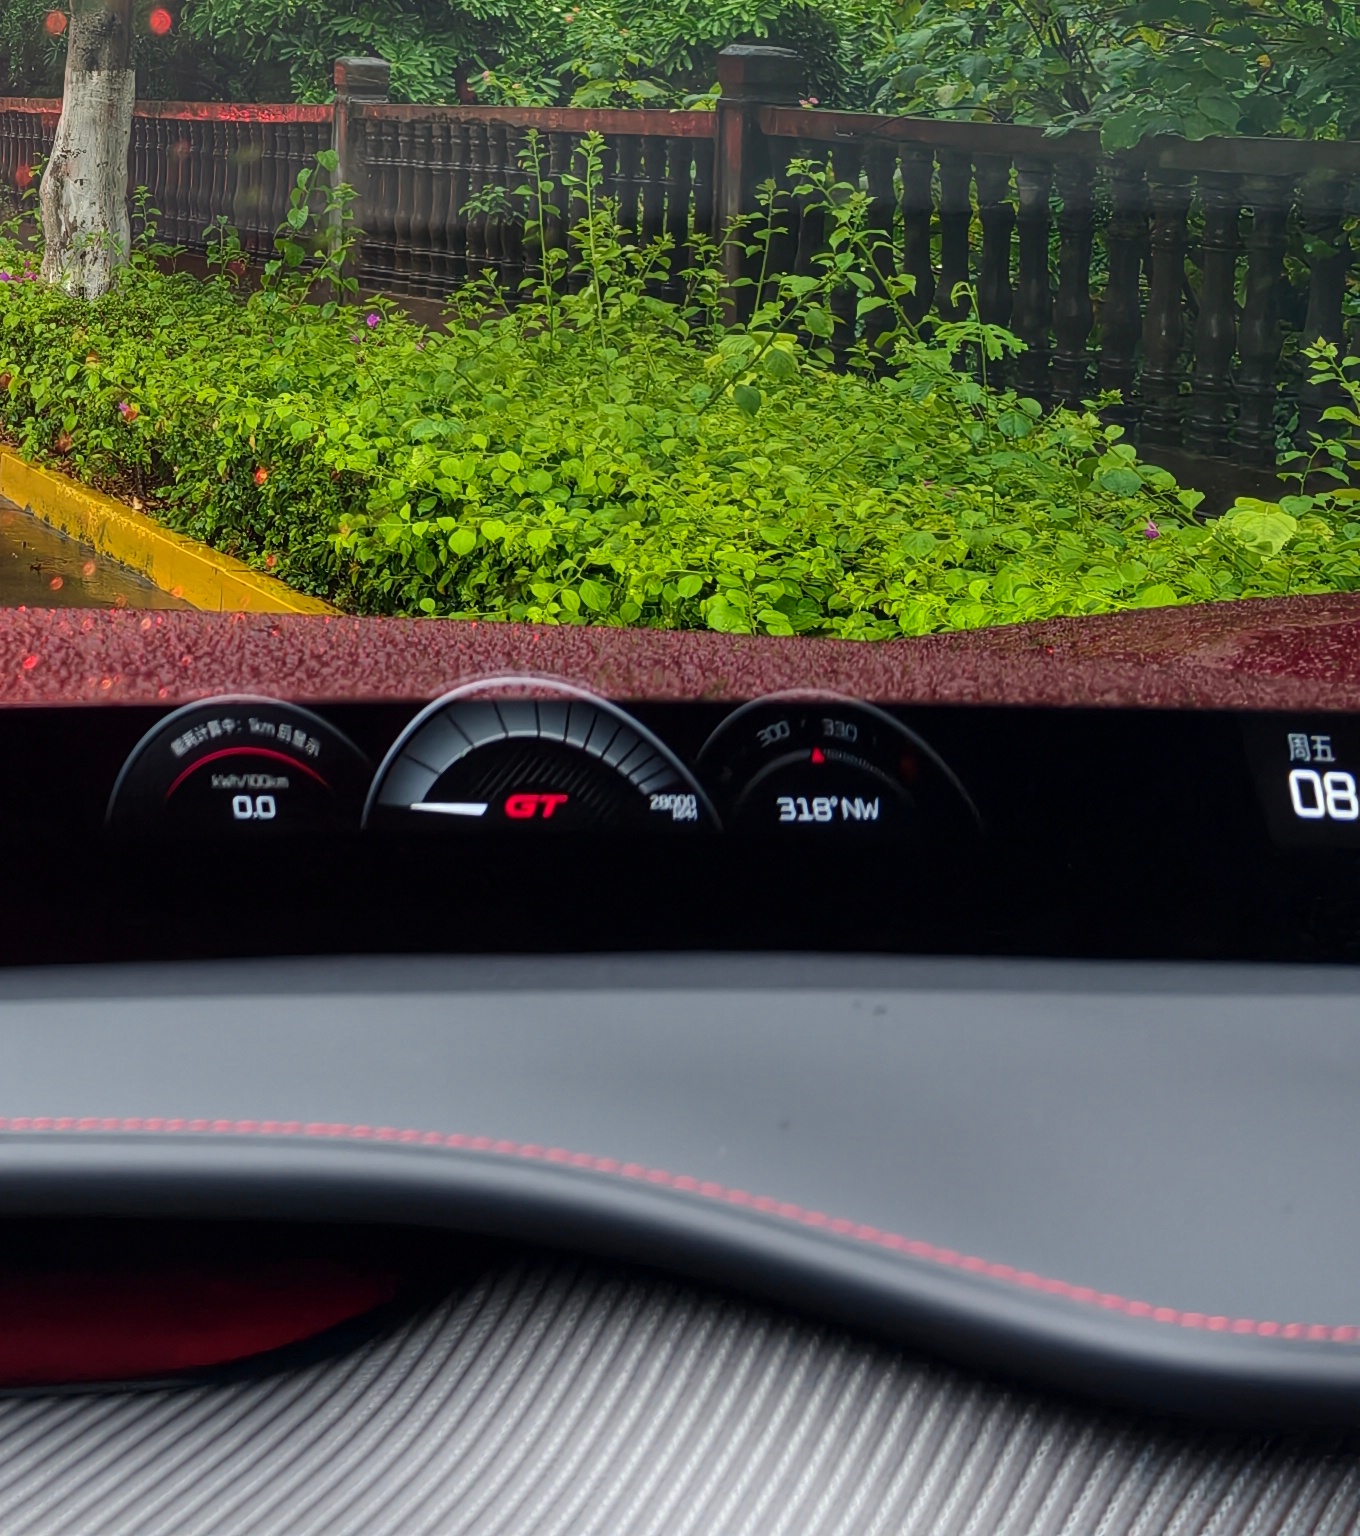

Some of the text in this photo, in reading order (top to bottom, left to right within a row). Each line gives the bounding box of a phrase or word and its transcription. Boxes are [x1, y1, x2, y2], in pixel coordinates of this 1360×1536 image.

[1287, 732, 1336, 763] 周五
[232, 794, 277, 820] 0.0
[504, 793, 569, 819] GT
[1288, 768, 1360, 821] 08
